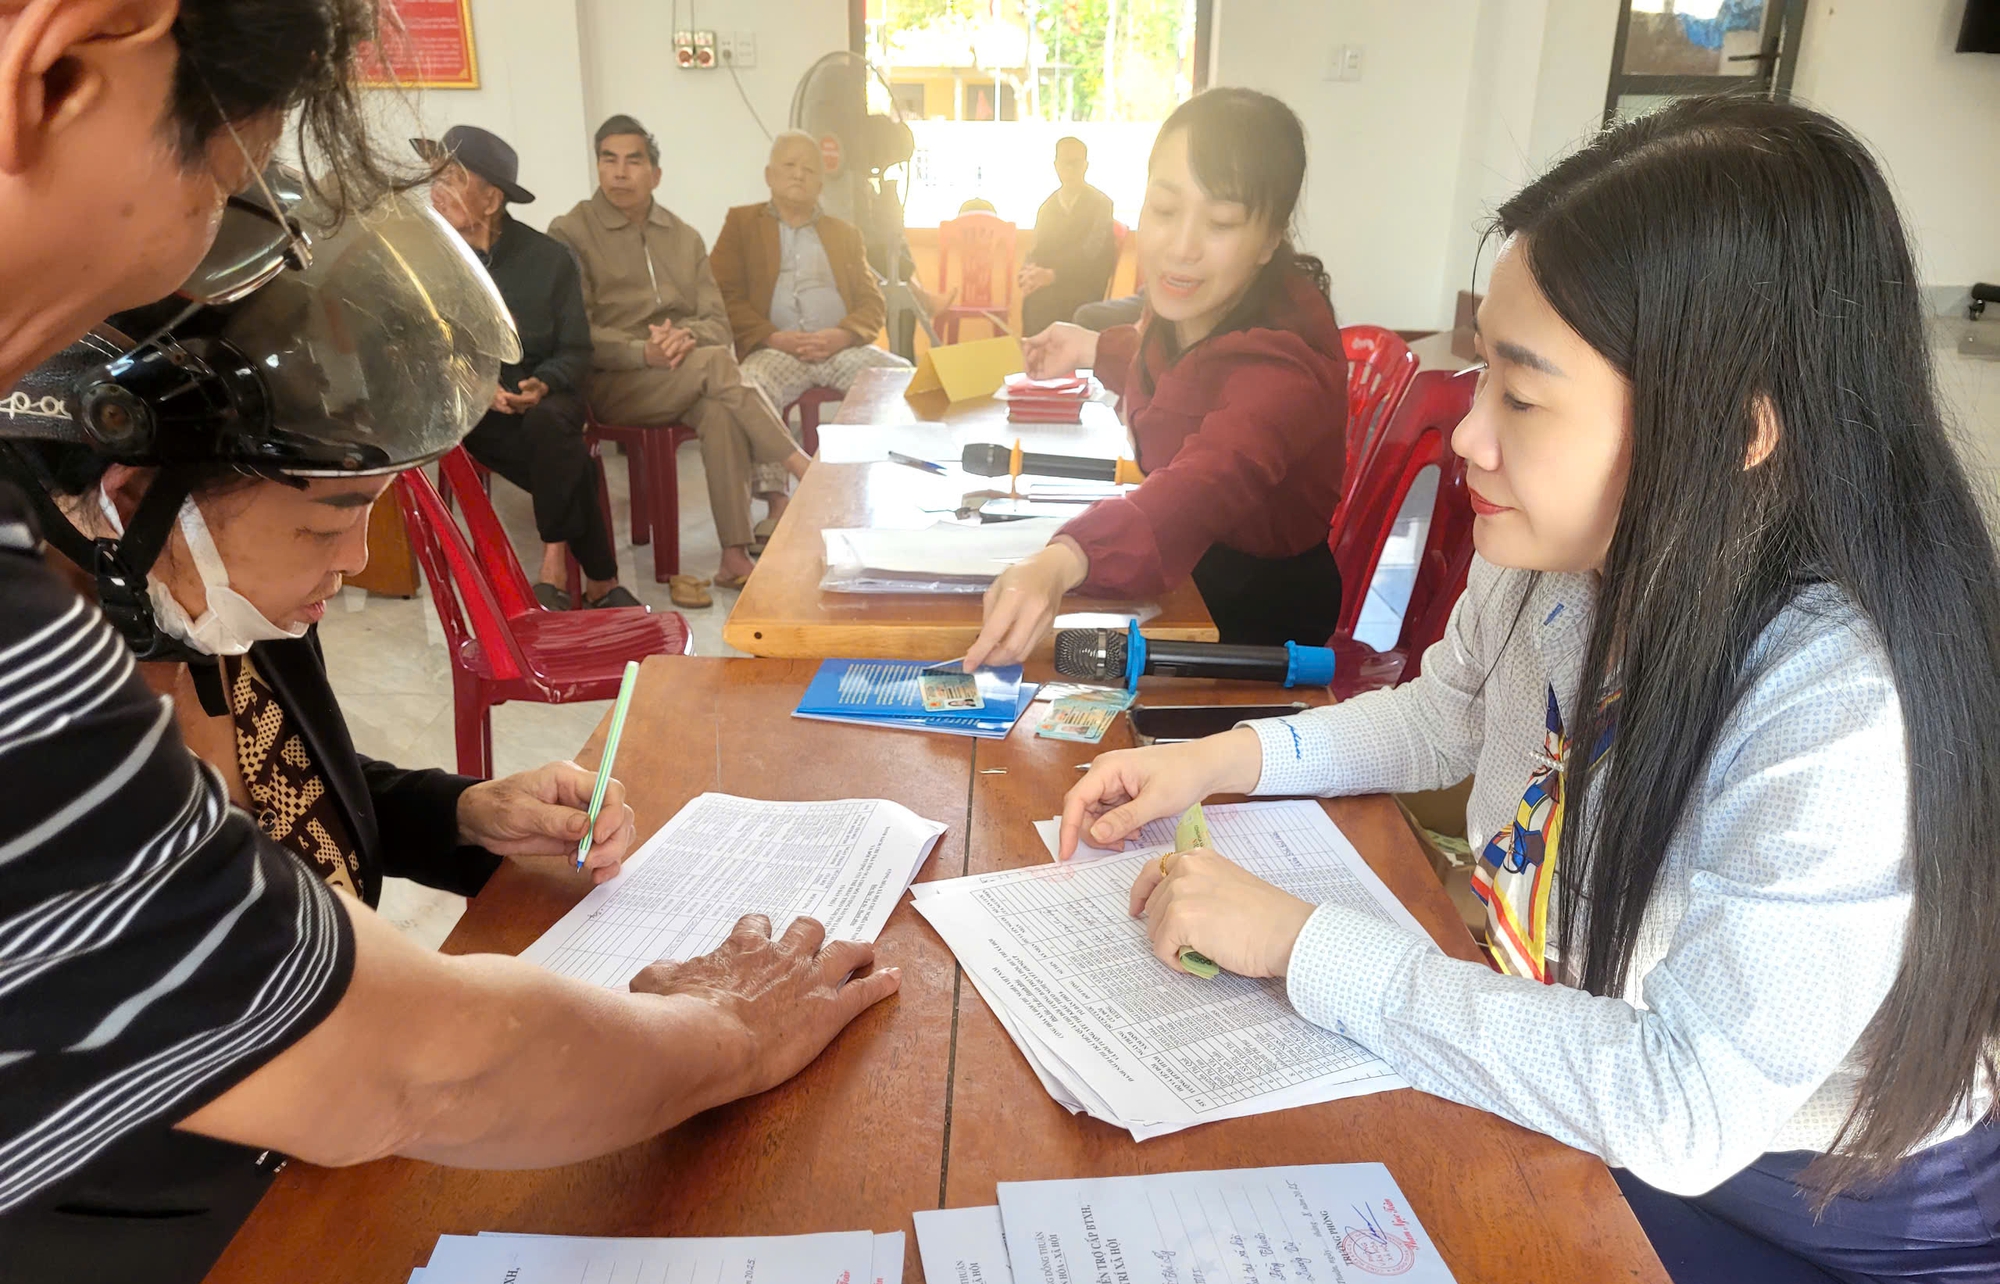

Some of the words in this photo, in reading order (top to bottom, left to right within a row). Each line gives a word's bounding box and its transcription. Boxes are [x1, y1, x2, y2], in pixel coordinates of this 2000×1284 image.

[1048, 1234, 1060, 1247] HỘI
[1106, 1239, 1121, 1254] HỘI
[1092, 1251, 1107, 1270] TRỢ
[1110, 1257, 1125, 1269] XÃ
